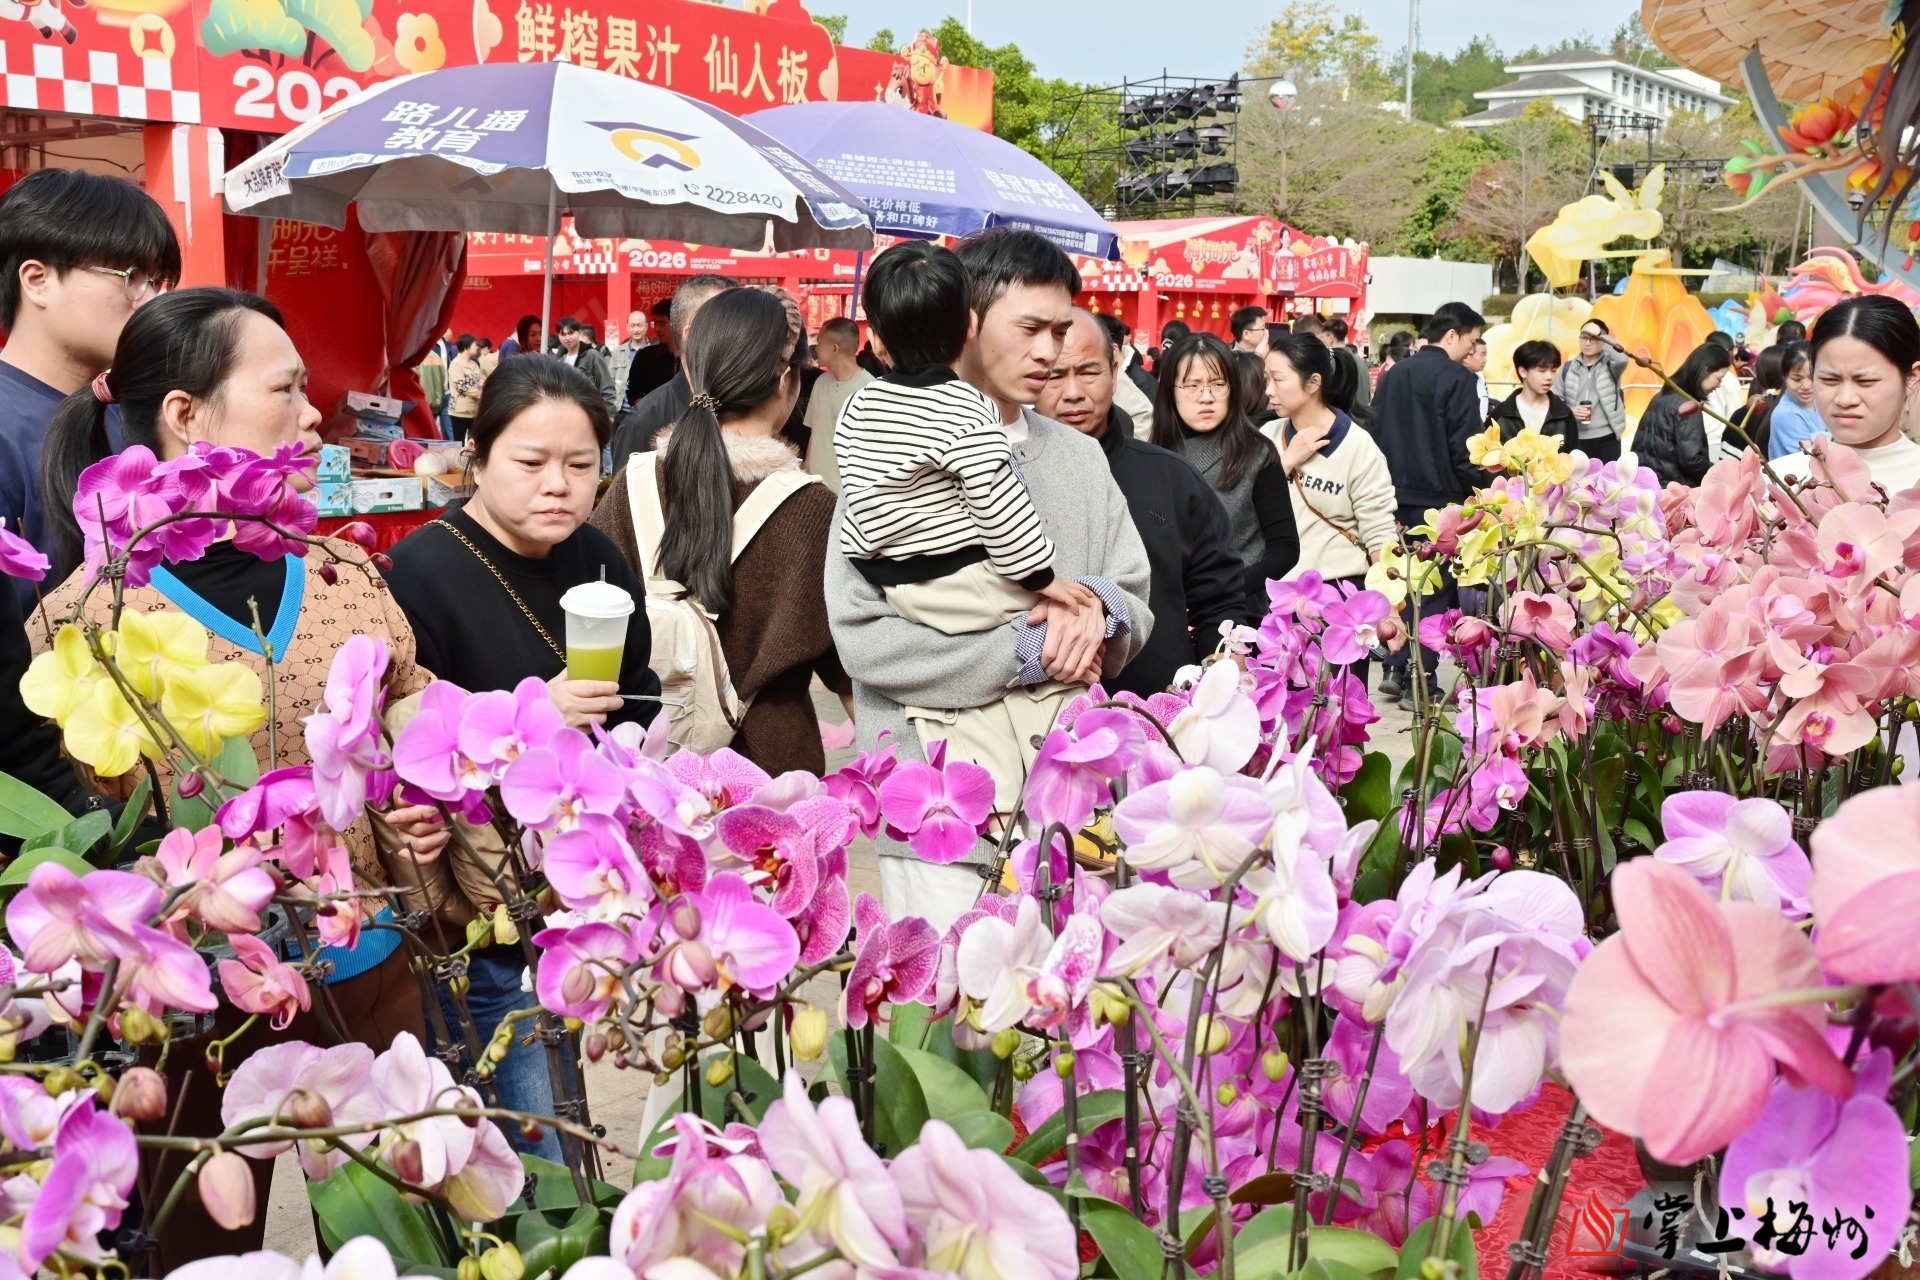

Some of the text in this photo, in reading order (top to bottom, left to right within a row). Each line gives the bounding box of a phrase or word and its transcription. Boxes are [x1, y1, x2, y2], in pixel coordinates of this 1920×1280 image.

[514, 1, 809, 104] 鲜榨果汁 仙人板
[232, 65, 364, 123] 202
[381, 101, 529, 132] 路儿通
[384, 126, 489, 152] 教育
[705, 185, 783, 209] 2228420
[629, 251, 687, 269] 2026
[1155, 273, 1193, 288] 2026
